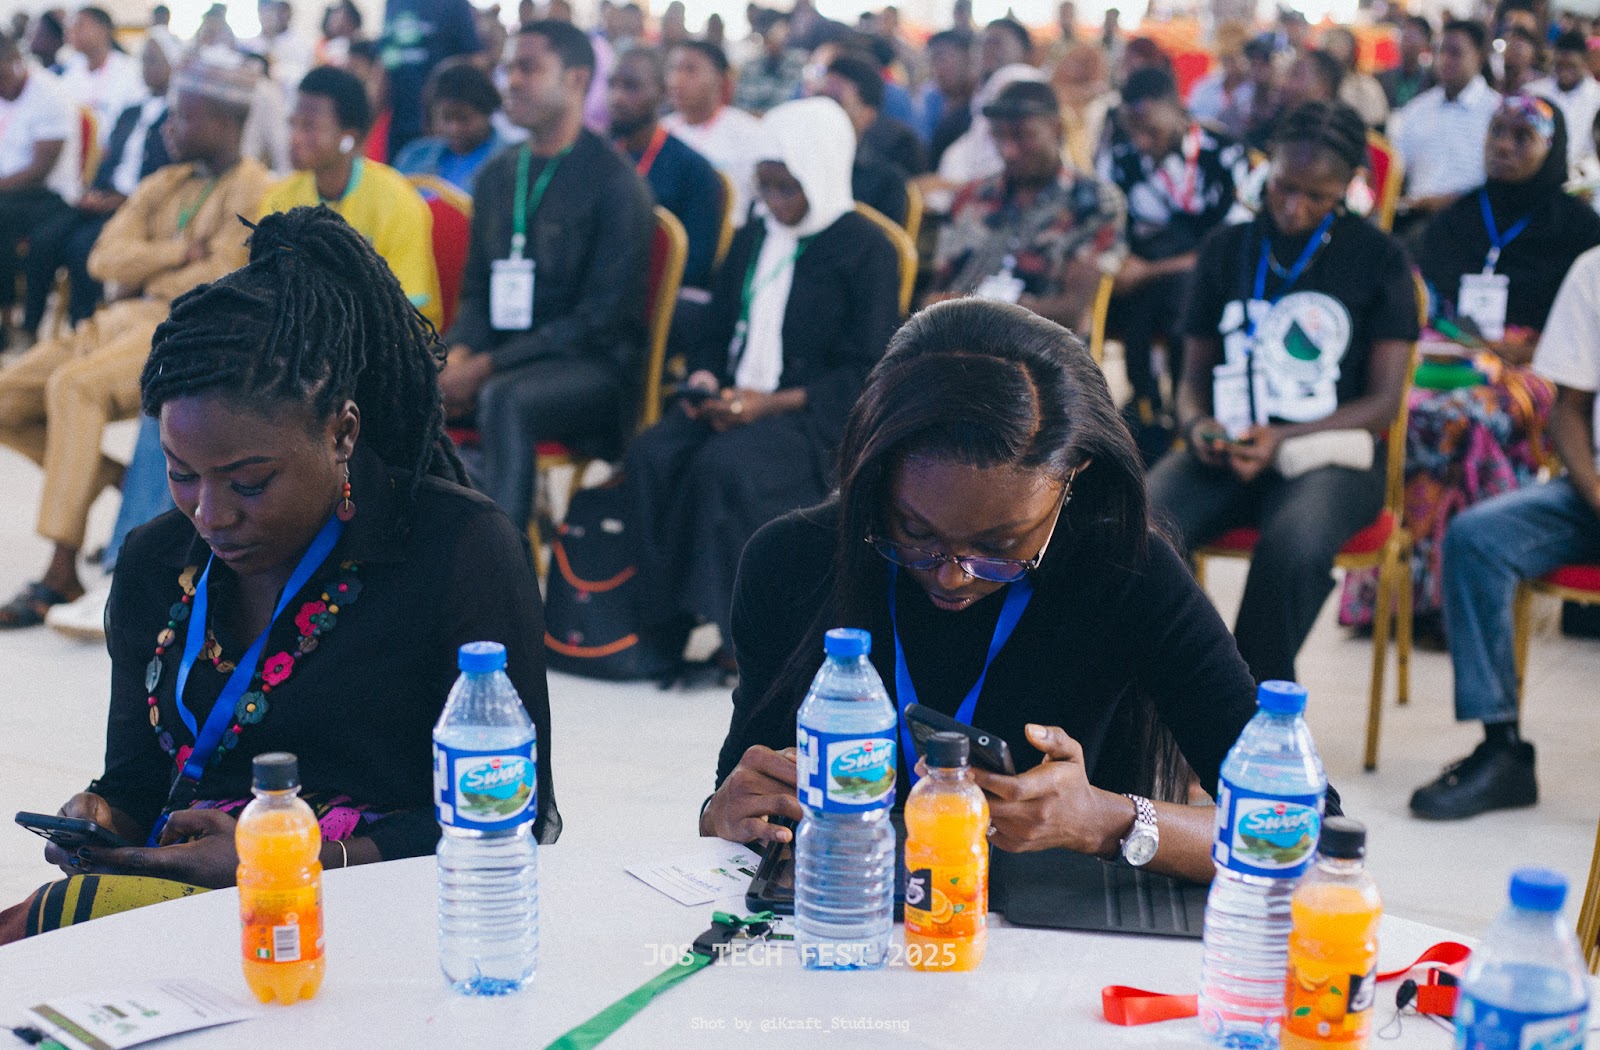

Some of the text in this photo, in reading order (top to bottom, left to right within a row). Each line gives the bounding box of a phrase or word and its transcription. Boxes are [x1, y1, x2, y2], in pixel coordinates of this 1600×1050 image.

[838, 745, 892, 770] Swan
[466, 761, 525, 787] Swan
[1245, 808, 1309, 829] Swan
[906, 877, 925, 904] 5
